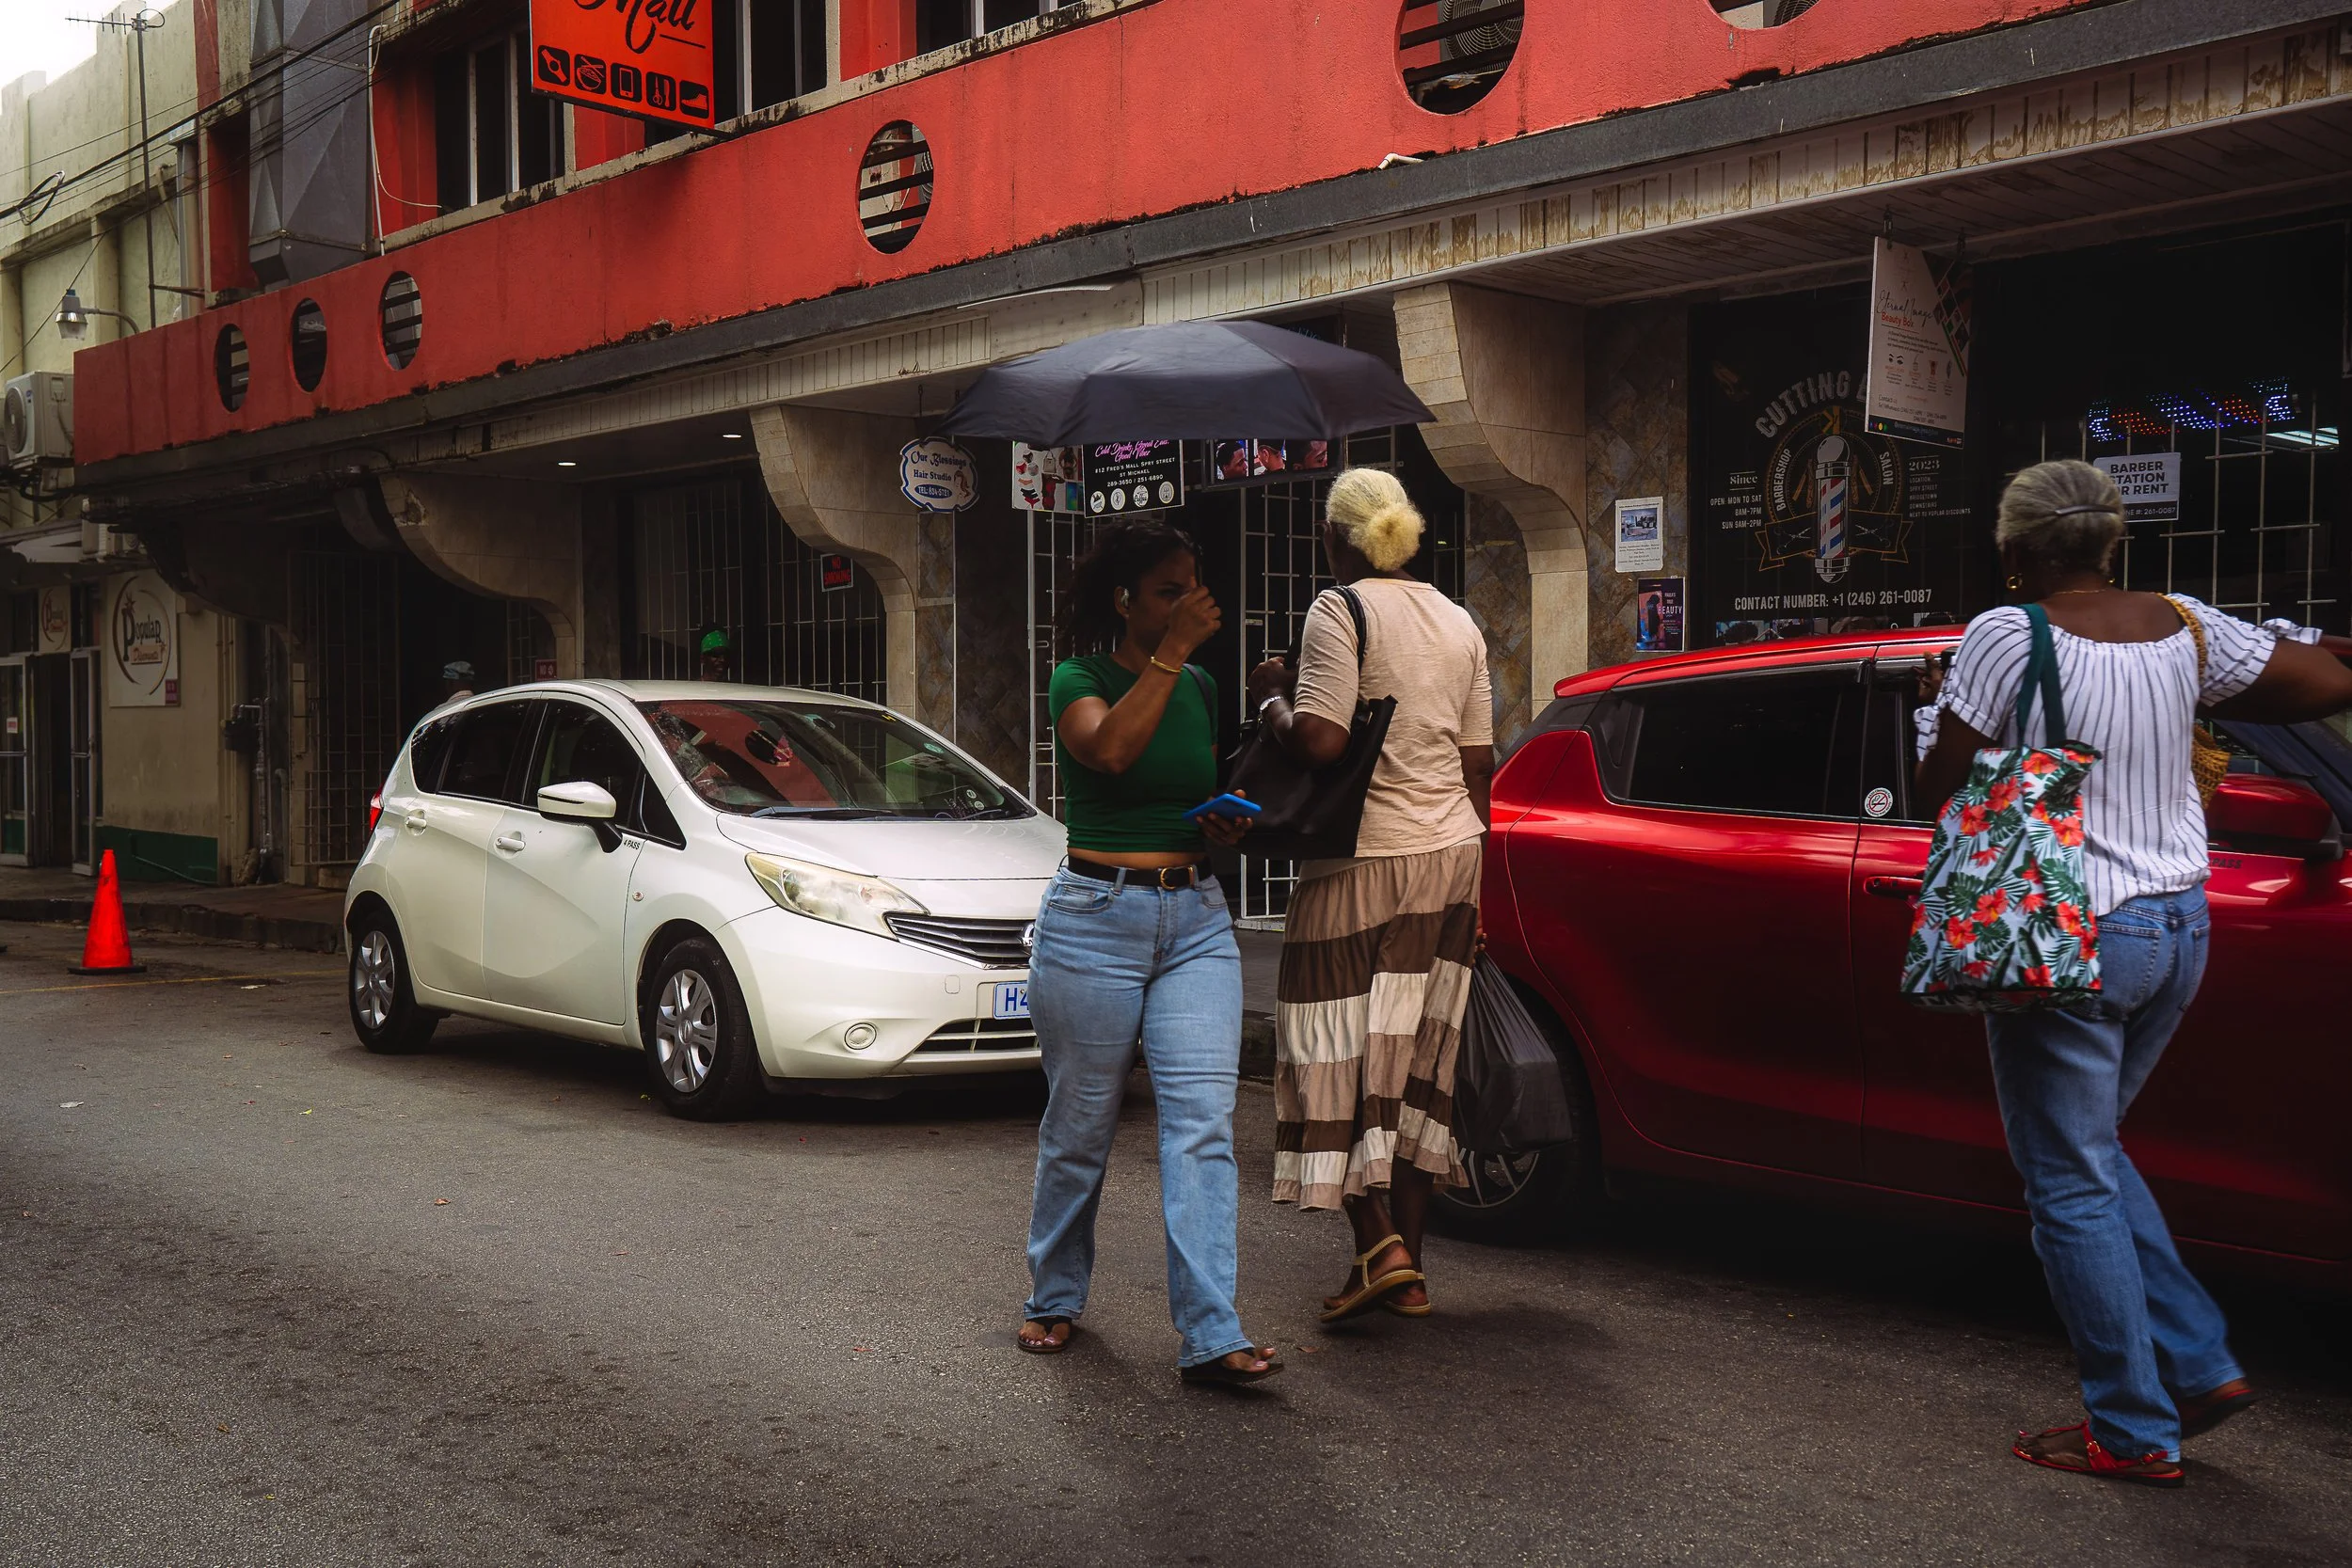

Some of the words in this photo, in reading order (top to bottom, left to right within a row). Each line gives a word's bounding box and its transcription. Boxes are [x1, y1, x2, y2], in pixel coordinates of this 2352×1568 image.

[1877, 289, 1909, 313] Eternal
[1910, 298, 1933, 327] Image
[1882, 311, 1901, 326] Beauty
[1903, 316, 1914, 327] Box
[1755, 371, 1851, 438] CUTTING
[1095, 444, 1111, 457] Cold
[911, 451, 928, 464] Our
[930, 452, 967, 469] Blessings
[1909, 460, 1941, 471] 2023
[1879, 451, 1894, 485] SALON
[2110, 461, 2163, 474] BARBER
[914, 469, 929, 479] Hair
[930, 471, 952, 482] Studio
[1729, 474, 1757, 484] Since
[1772, 448, 1792, 512] BARBERSHOP
[2133, 483, 2169, 495] RENT
[1727, 496, 1741, 504] MON
[1751, 494, 1762, 503] SAT
[1735, 507, 1762, 516] 8AM-7PM
[2144, 507, 2176, 515] 261-0087
[1722, 521, 1734, 530] SUN
[1734, 595, 1780, 610] CONTACT
[1783, 594, 1829, 609] NUMBER:
[1832, 593, 1844, 607] +1
[1847, 591, 1876, 607] (246)
[1879, 588, 1932, 605] 261-0087
[1658, 605, 1683, 614] BEAUTY
[627, 840, 641, 850] PASS
[2212, 857, 2243, 869] PASS
